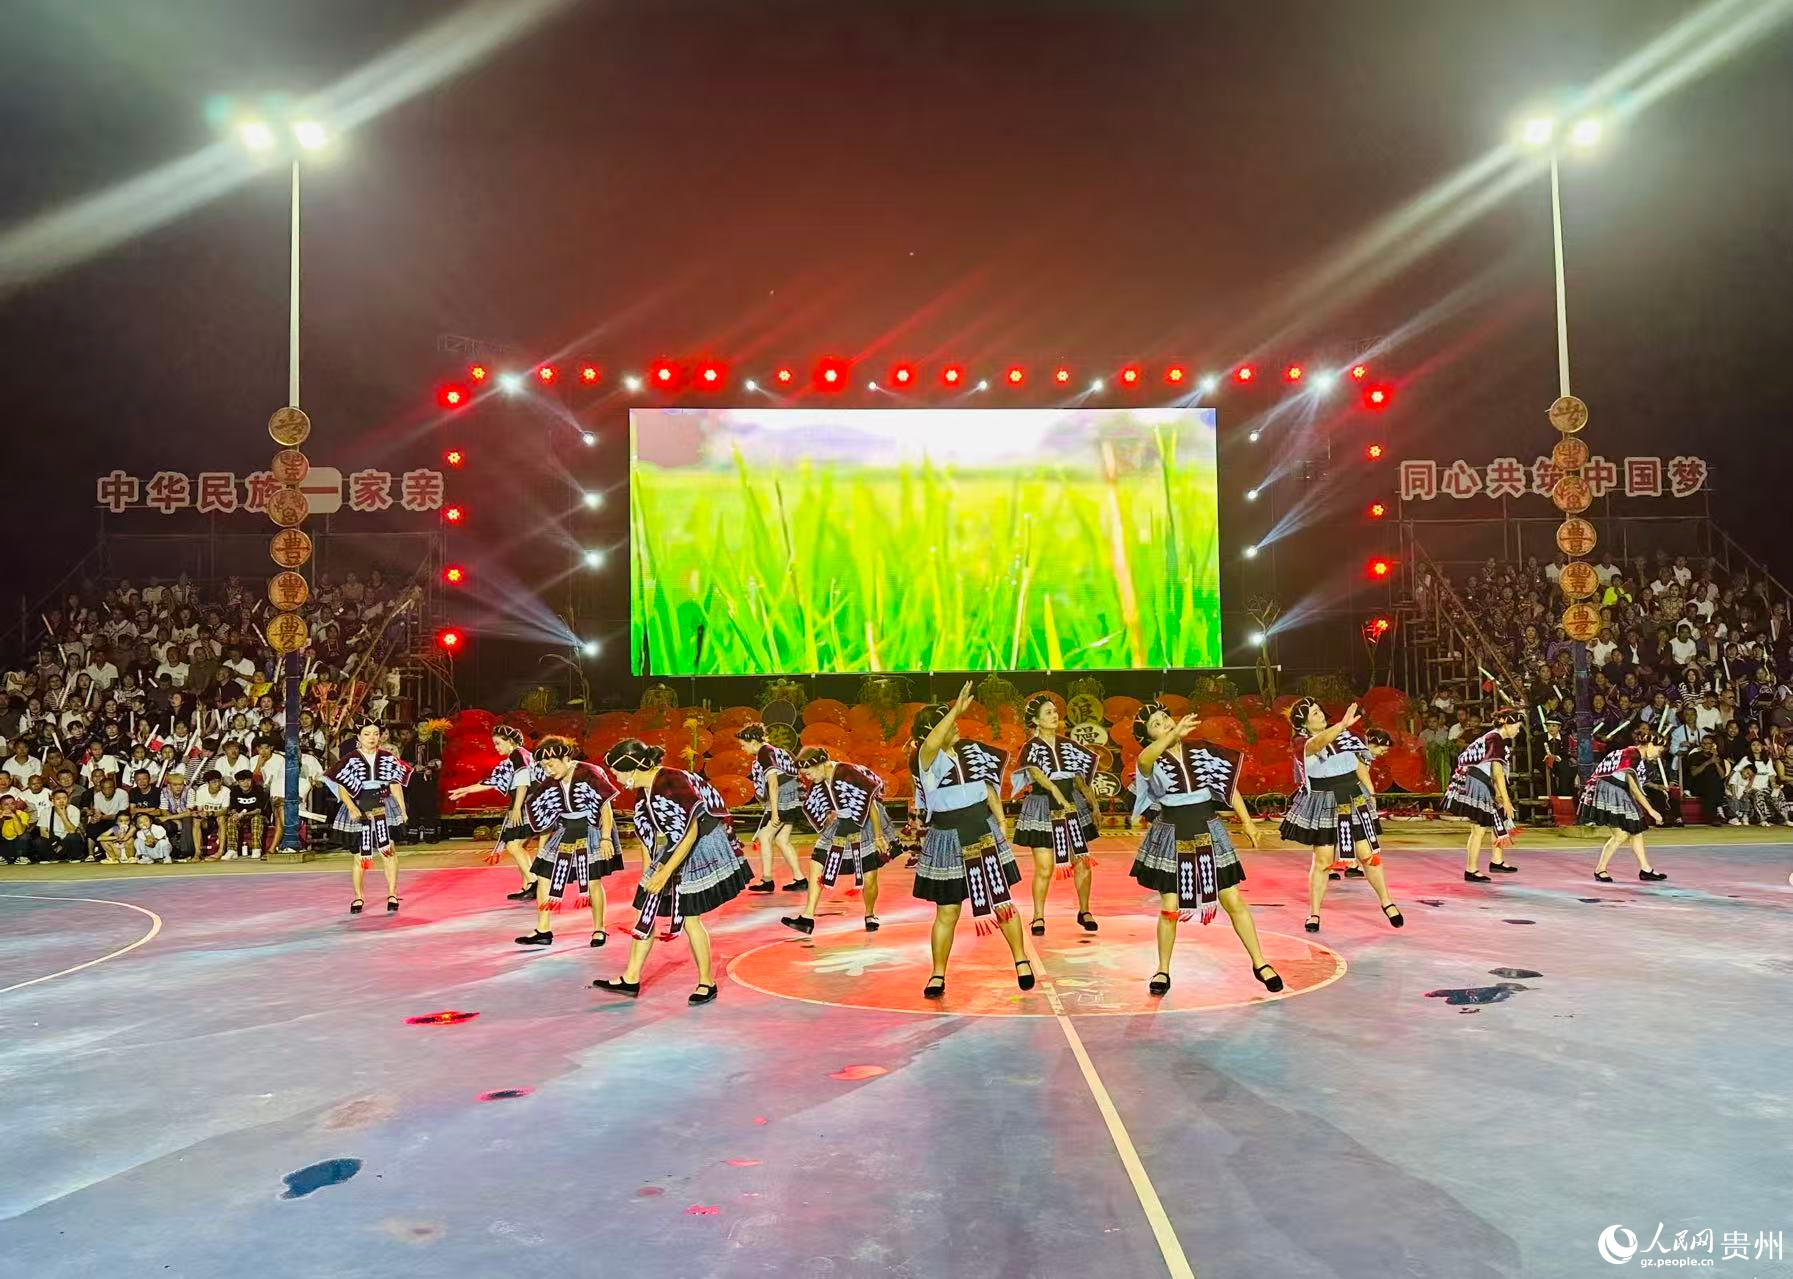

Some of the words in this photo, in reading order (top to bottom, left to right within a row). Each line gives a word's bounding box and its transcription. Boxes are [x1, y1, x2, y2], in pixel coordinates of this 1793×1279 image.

[1402, 457, 1706, 499] 同心共筑中国梦
